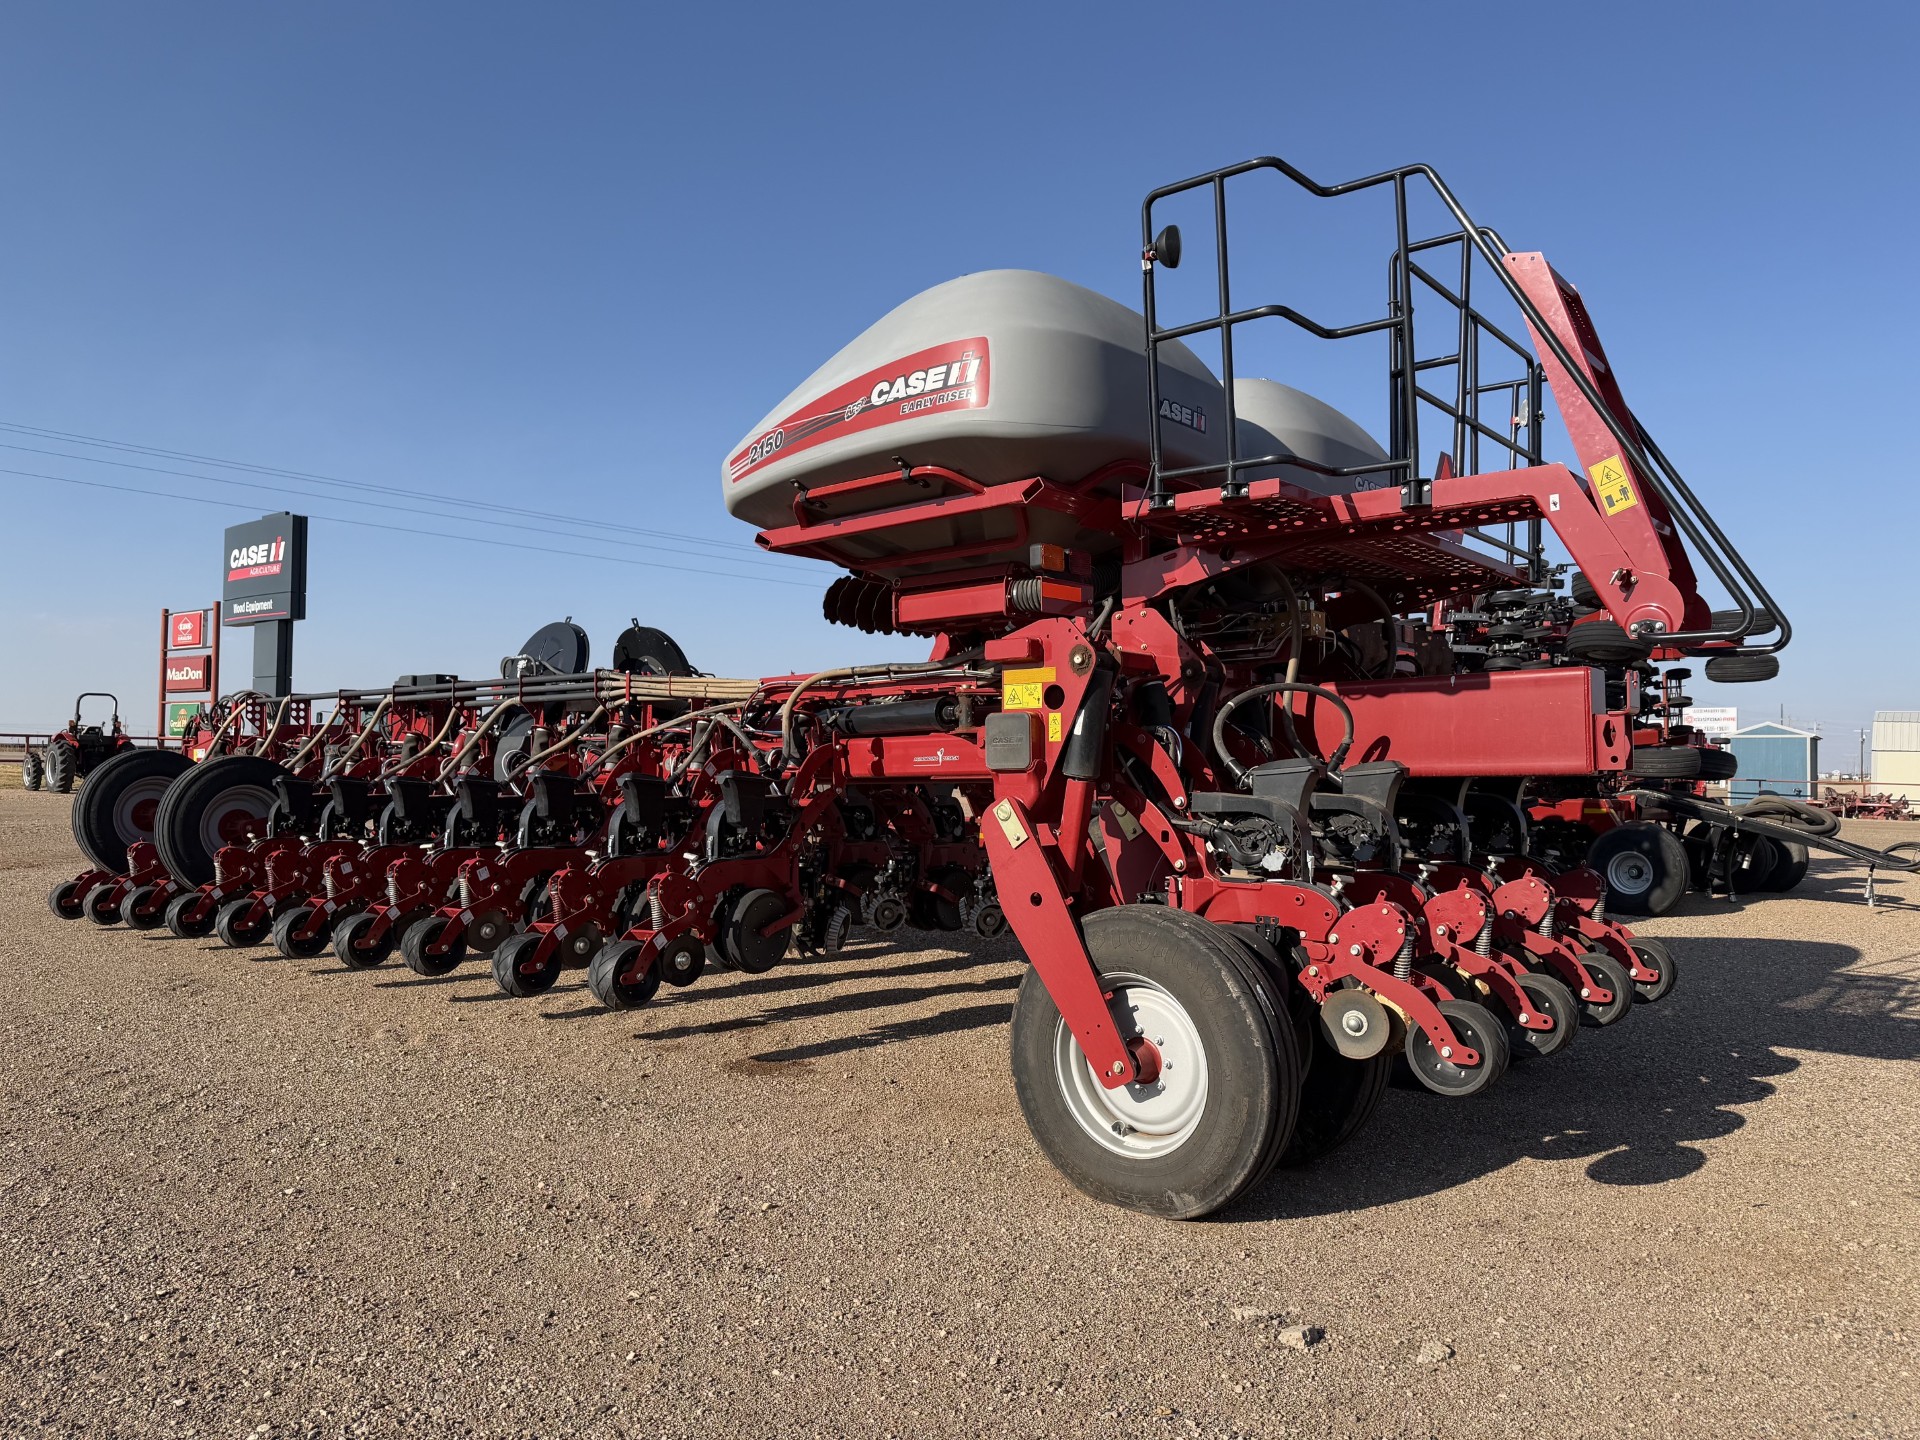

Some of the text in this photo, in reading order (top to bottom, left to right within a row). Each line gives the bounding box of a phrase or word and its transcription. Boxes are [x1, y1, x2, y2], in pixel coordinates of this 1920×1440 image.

[870, 363, 948, 405] CASE
[900, 396, 936, 415] EARLY
[1160, 400, 1192, 426] ASE
[749, 429, 784, 466] 2150
[230, 543, 269, 569] CASE
[249, 565, 281, 576] AGRICULTURE
[233, 599, 273, 614] Wood Equipment
[167, 666, 203, 681] MacDon
[992, 736, 1015, 744] CASE
